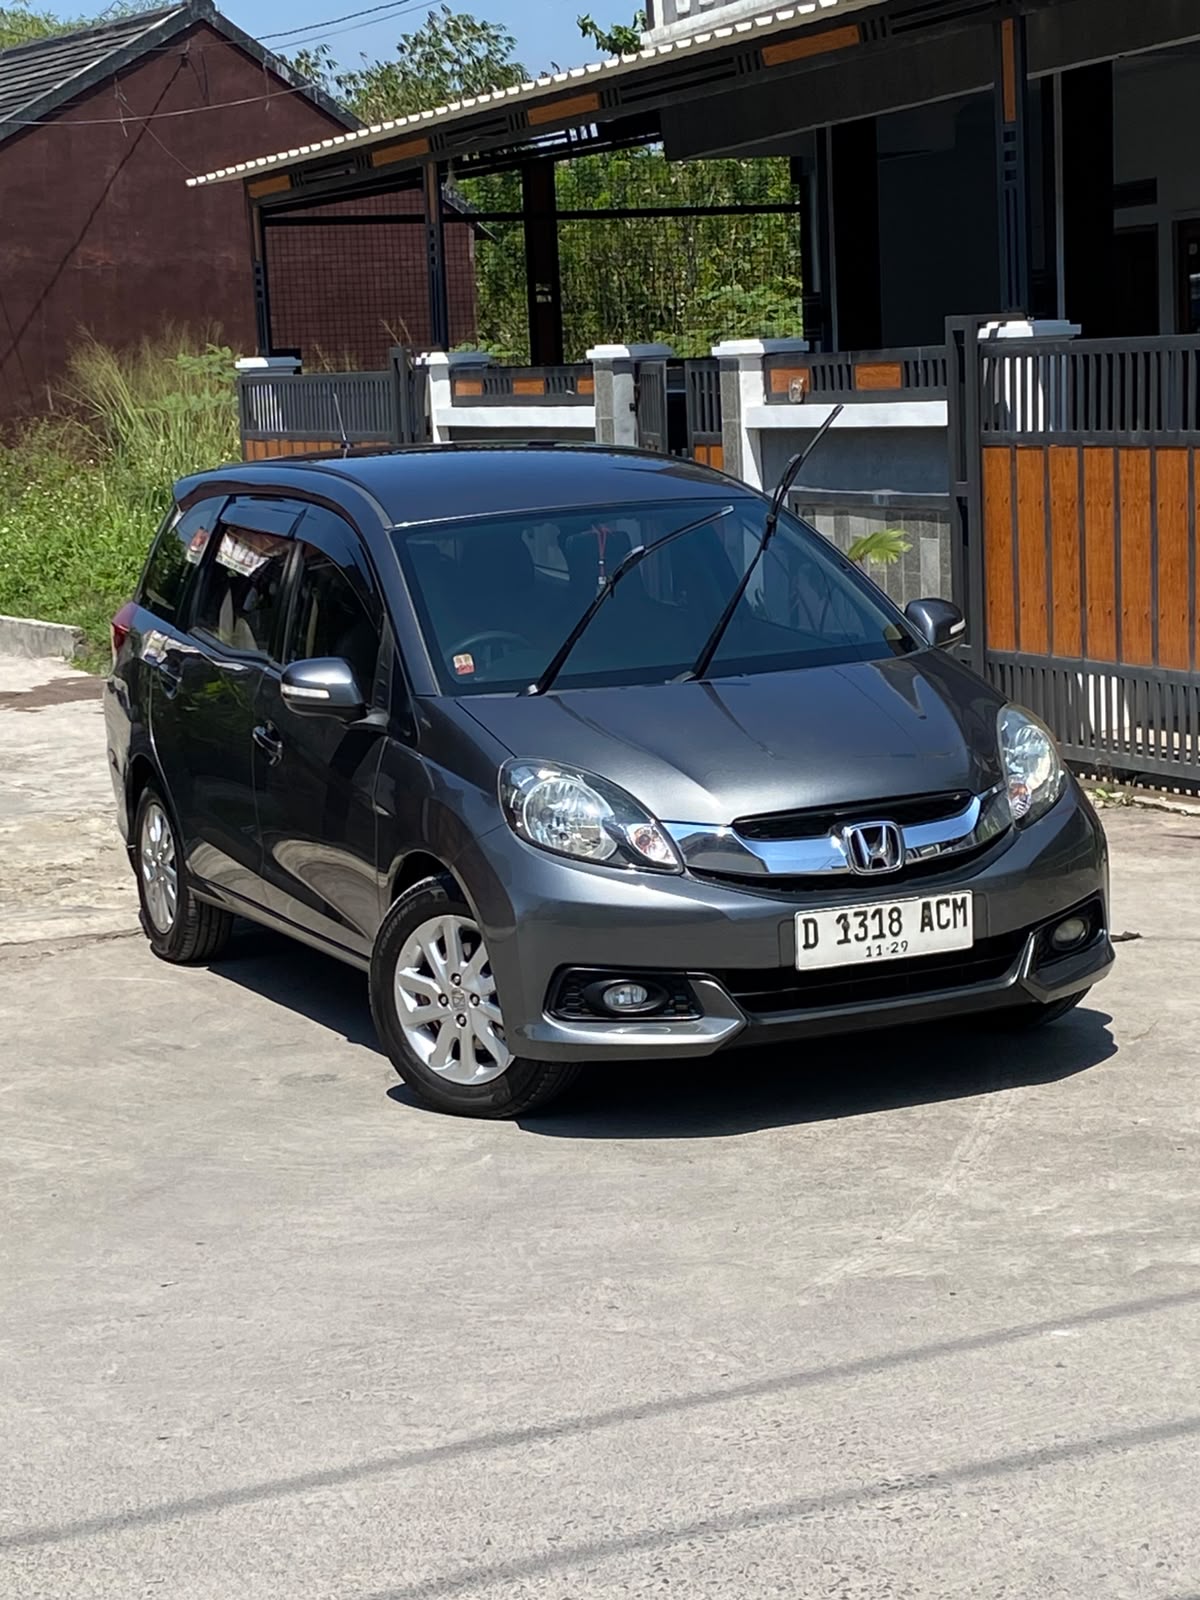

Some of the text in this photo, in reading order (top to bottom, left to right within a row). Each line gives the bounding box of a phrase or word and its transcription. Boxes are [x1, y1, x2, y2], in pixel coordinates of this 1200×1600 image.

[802, 896, 968, 950] D 1318 ACM
